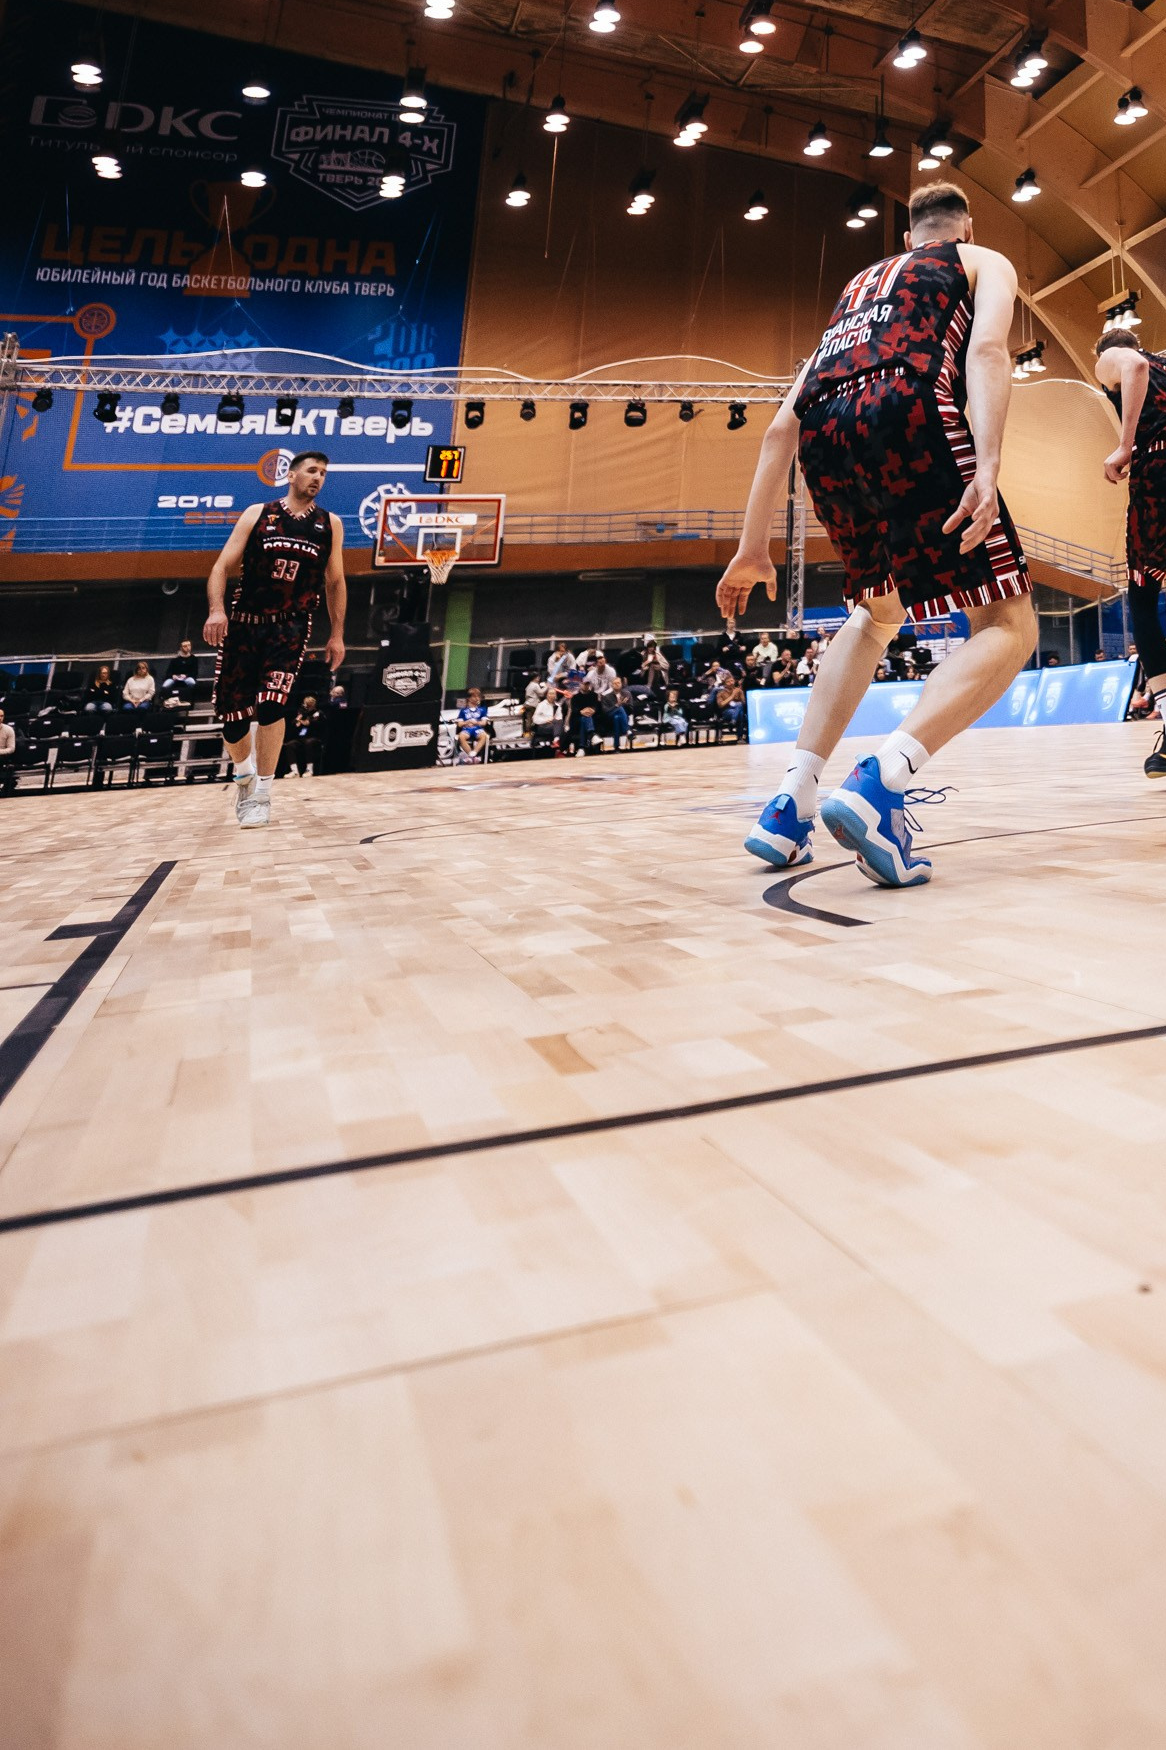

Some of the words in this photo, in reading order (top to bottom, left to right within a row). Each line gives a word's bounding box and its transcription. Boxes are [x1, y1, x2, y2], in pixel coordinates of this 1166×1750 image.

[104, 102, 242, 142] DKC
[323, 108, 388, 122] ЧЕМПИОНАТ
[290, 124, 390, 144] ФИНАЛ
[149, 144, 238, 163] спонсор
[318, 173, 363, 186] ТВЕРЬ
[40, 223, 204, 266] ЦЕЛЬ
[243, 234, 397, 277] ОДНА
[36, 267, 136, 286] ЮБИЛЕЙНЫЙ
[140, 272, 167, 289] ГОД
[172, 273, 301, 293] БАСКЕТБОЛЬНОГО
[305, 280, 349, 295] КЛУБА
[354, 282, 395, 297] ТВЕРЬ
[840, 252, 914, 314] 41
[271, 558, 300, 581] 33
[267, 671, 295, 693] 33
